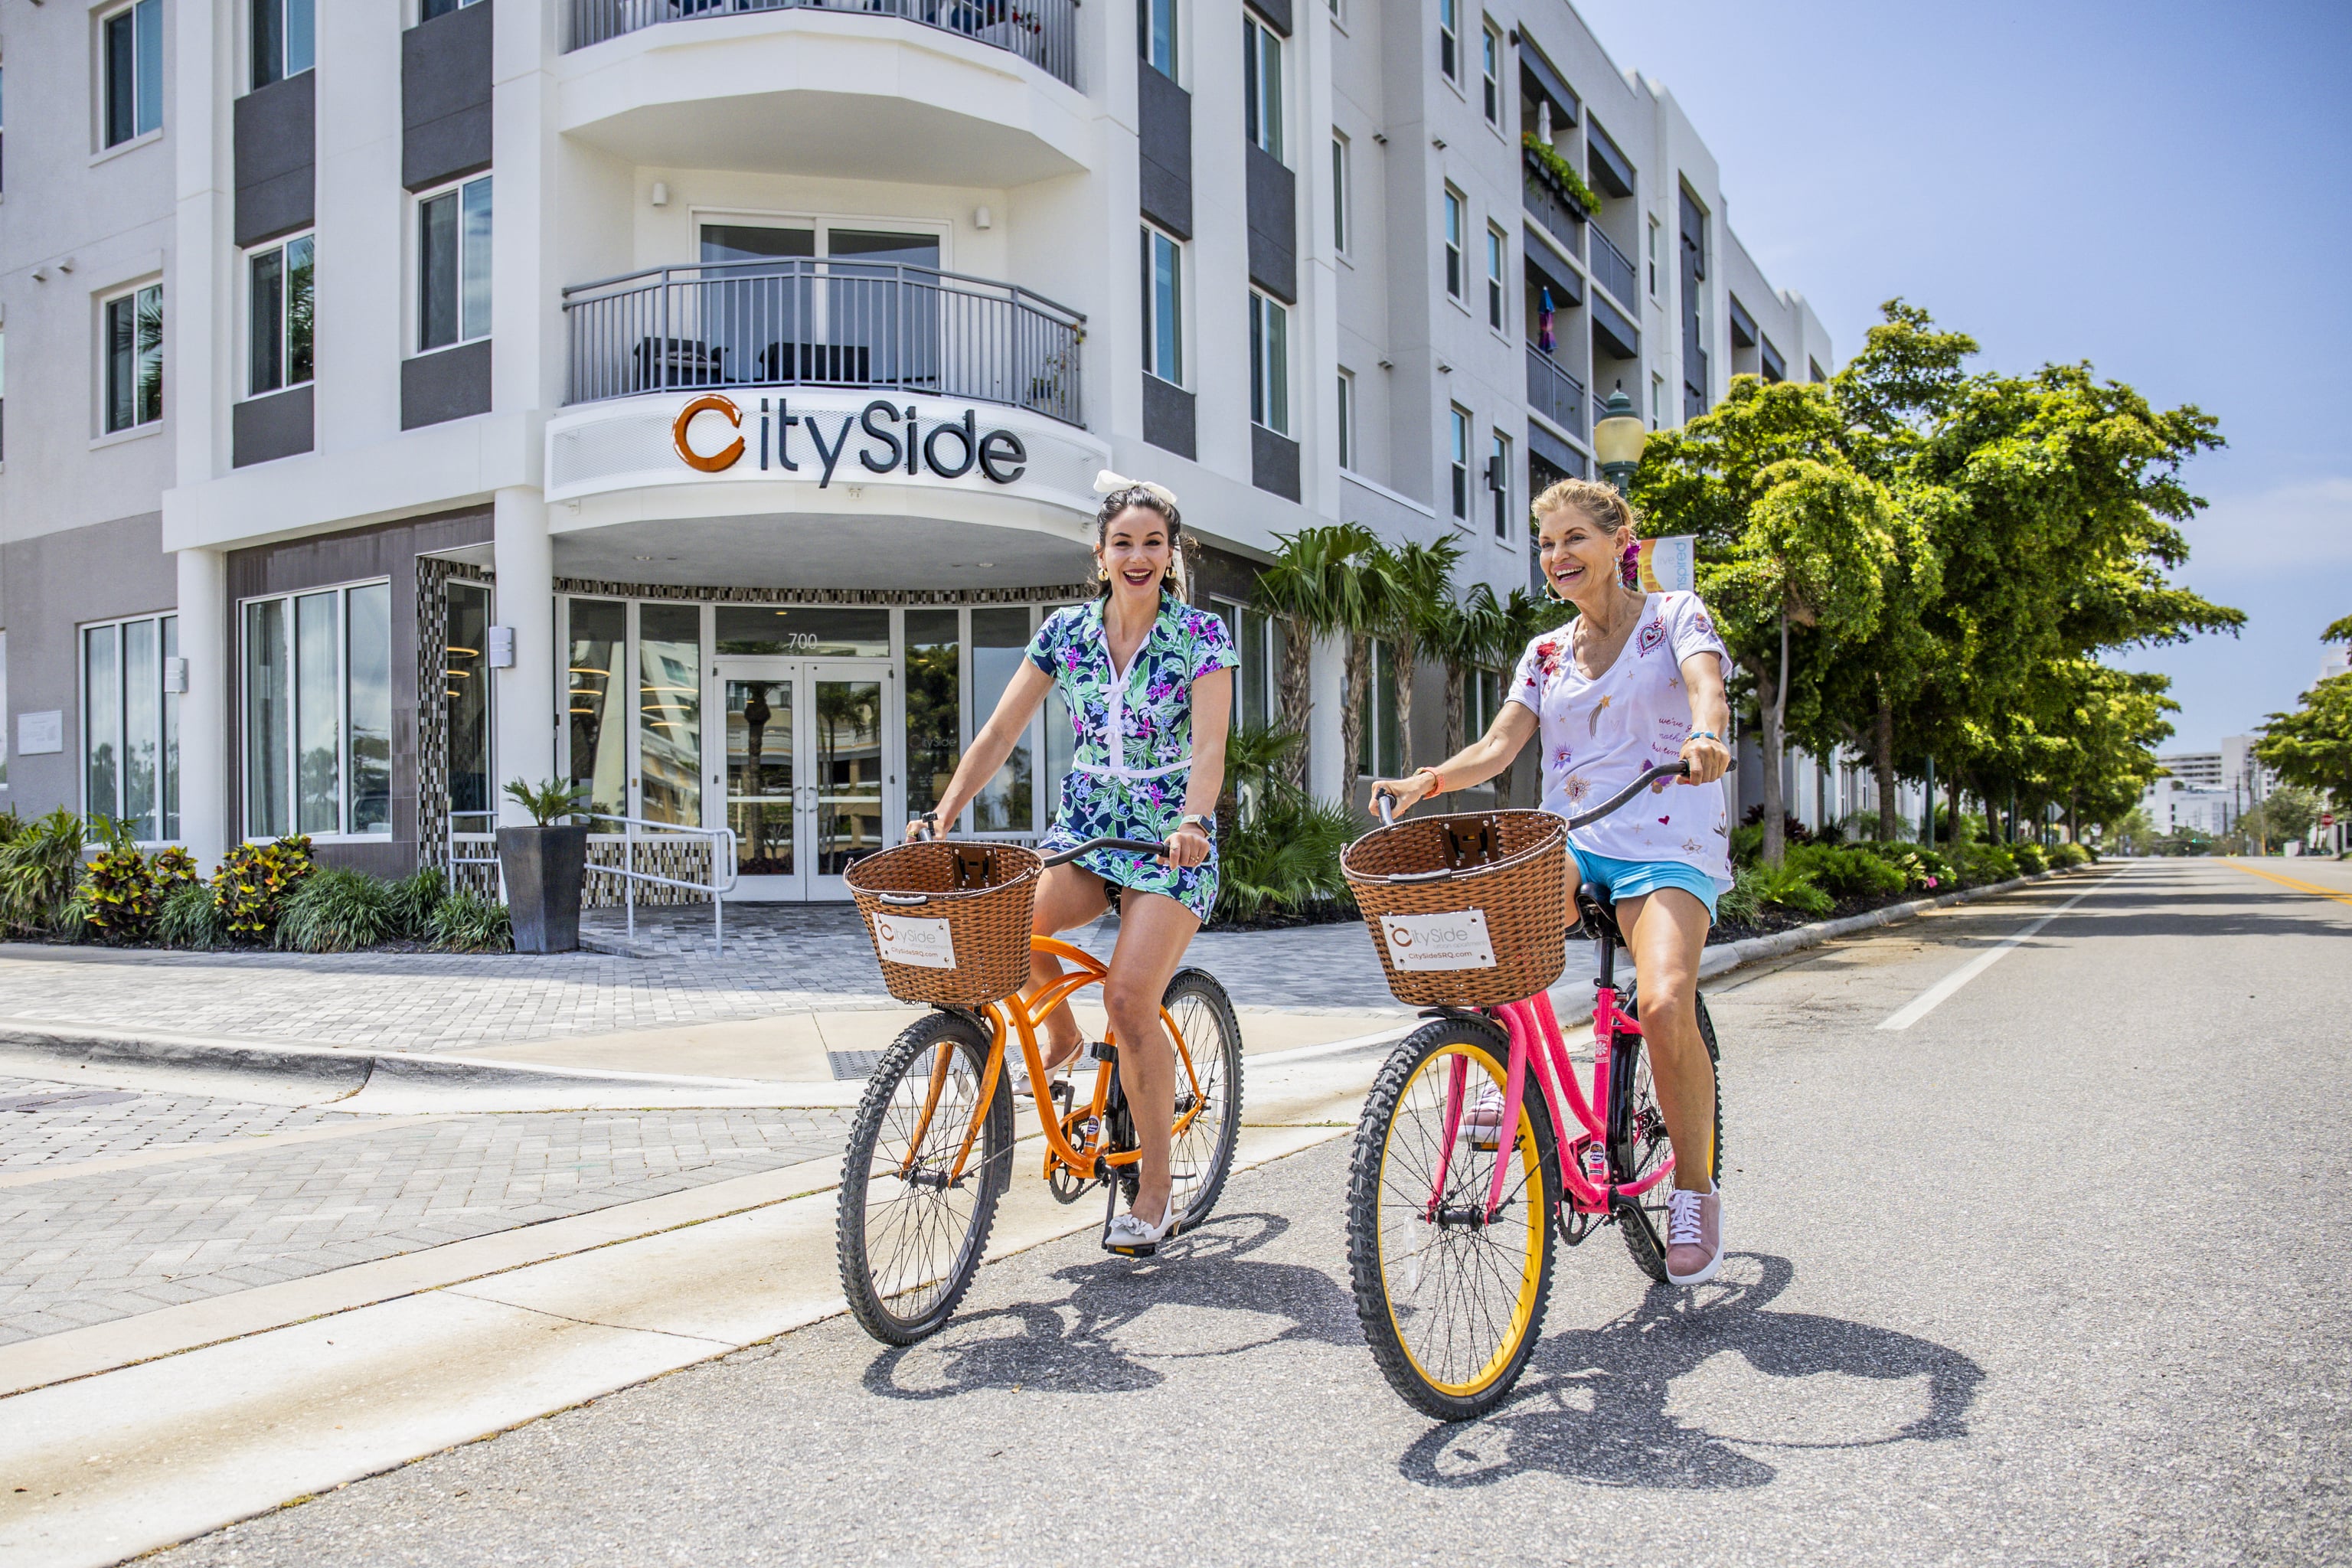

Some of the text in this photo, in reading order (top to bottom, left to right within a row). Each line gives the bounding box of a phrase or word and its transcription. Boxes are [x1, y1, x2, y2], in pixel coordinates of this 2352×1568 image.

[671, 393, 1027, 488] CitySide
[1674, 542, 1690, 590] nspired
[788, 632, 817, 649] 700
[1658, 717, 1684, 727] we've
[1659, 733, 1685, 743] nothi
[1663, 747, 1681, 757] tim
[880, 923, 936, 944] CitySide
[1391, 926, 1468, 947] CitySide
[890, 946, 939, 958] CitySideSRQ.com
[1408, 950, 1473, 960] CitySideSRQ.com
